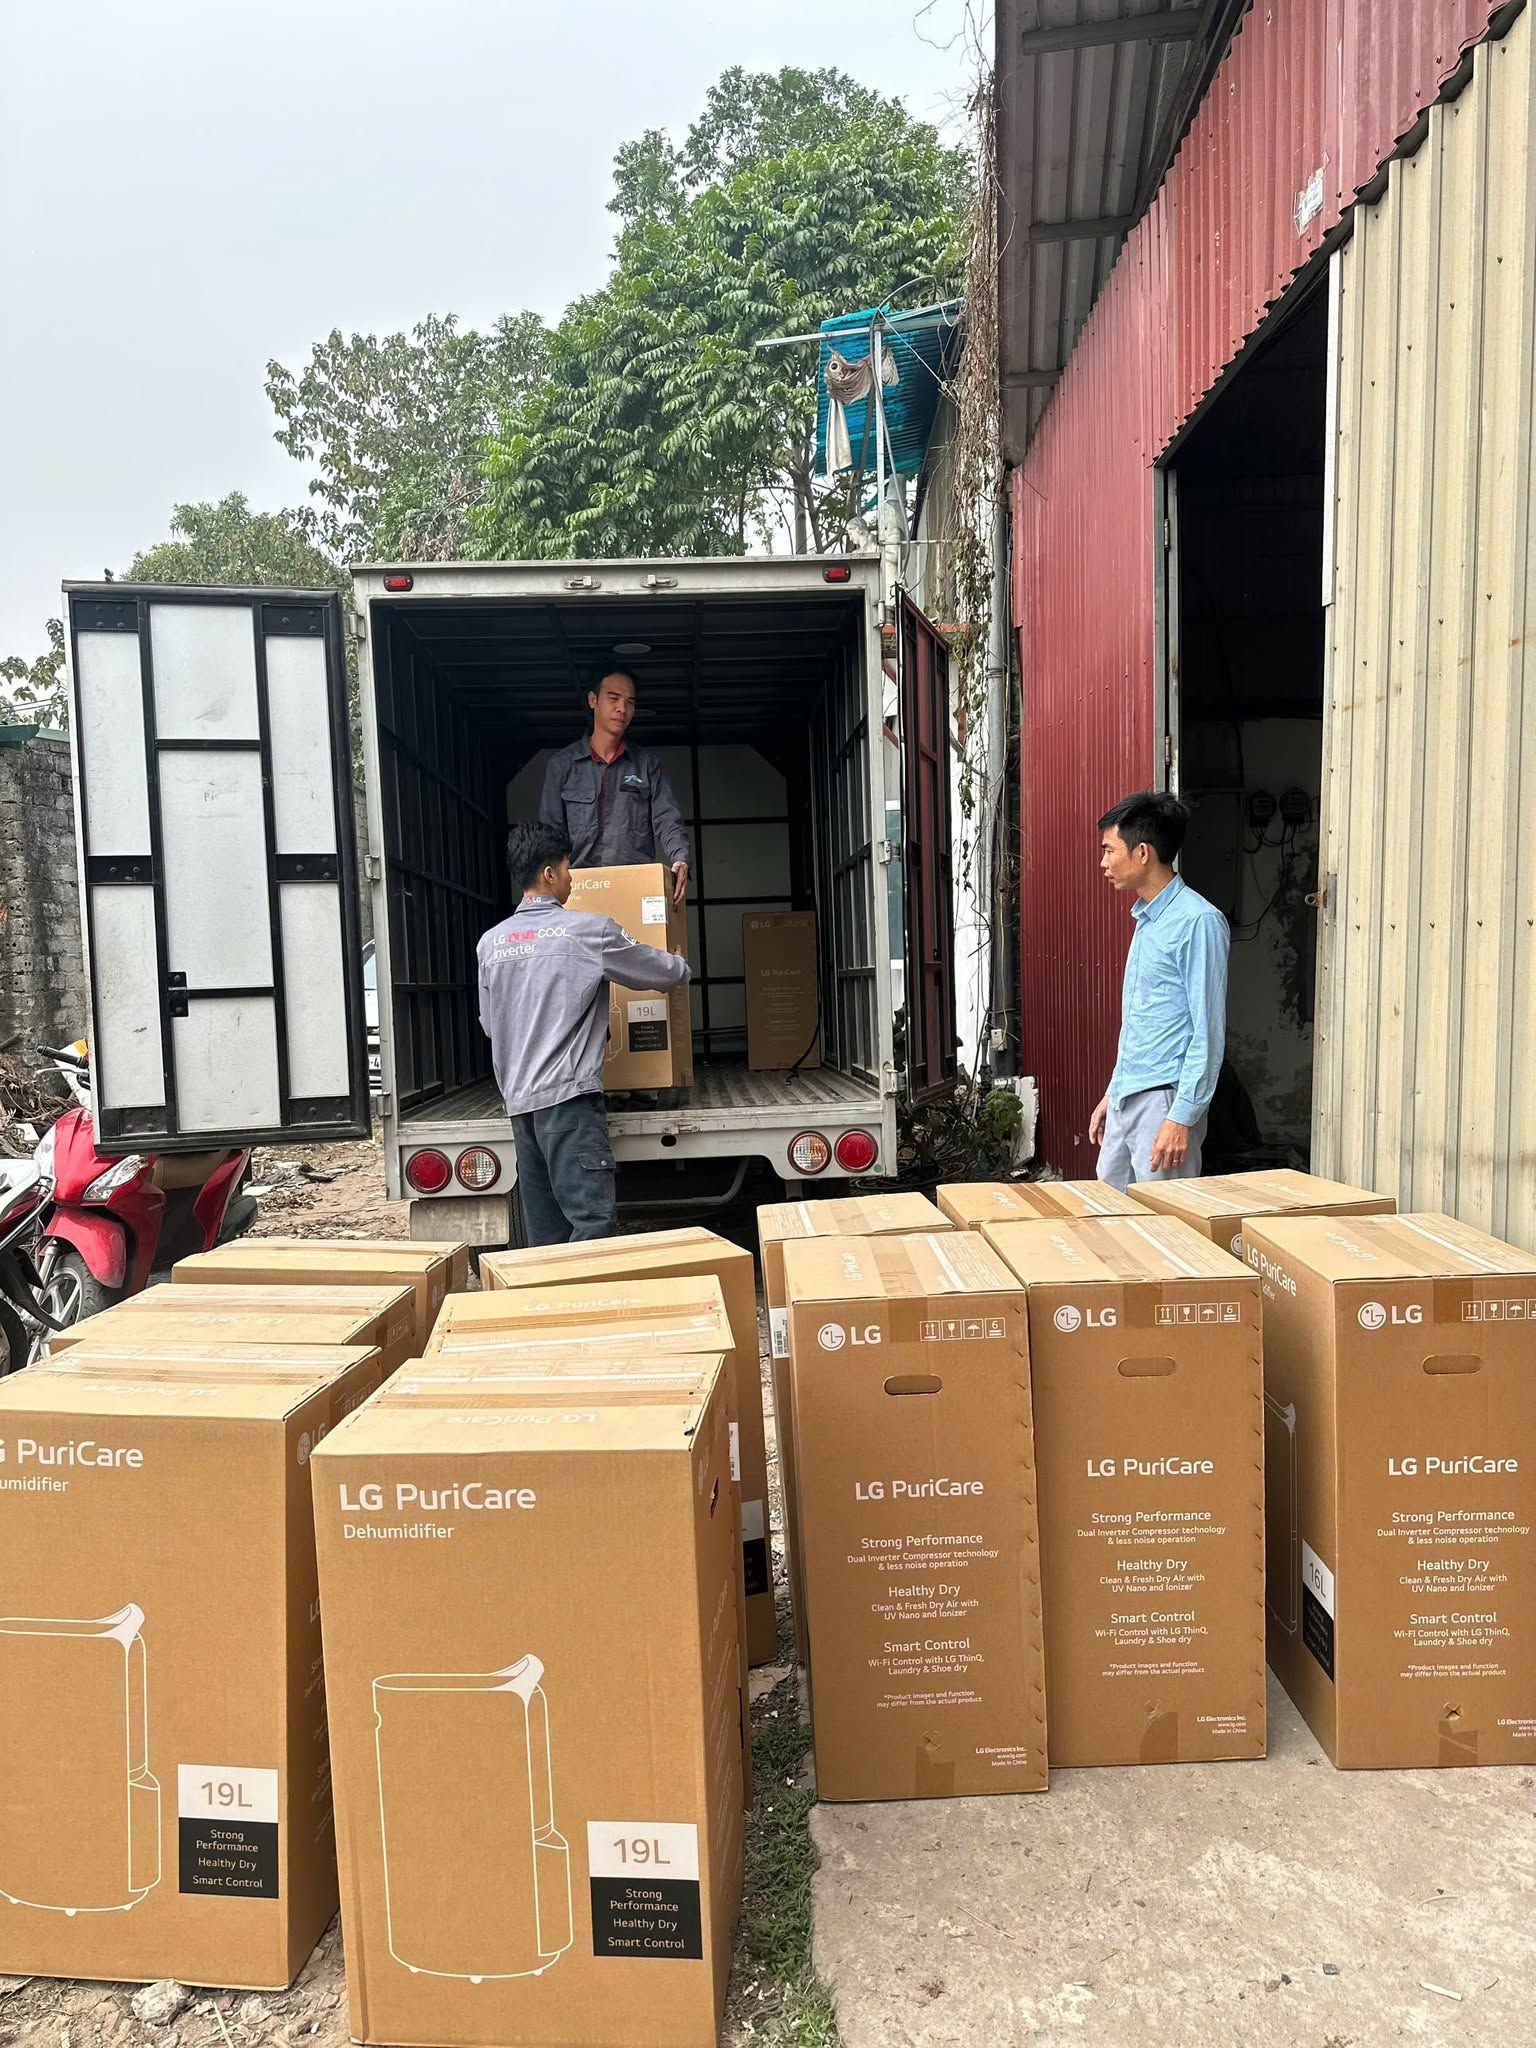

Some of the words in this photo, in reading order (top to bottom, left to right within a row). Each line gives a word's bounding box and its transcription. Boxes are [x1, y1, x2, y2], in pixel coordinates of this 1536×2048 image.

[571, 879, 611, 891] uriCare
[493, 934, 505, 945] LG
[538, 928, 570, 939] COOL
[636, 1006, 656, 1016] 19L
[1247, 1244, 1258, 1268] LG
[1261, 1253, 1296, 1297] PuriCare
[523, 1301, 548, 1312] LG
[558, 1297, 643, 1310] PuriCare
[1226, 1304, 1234, 1314] 6
[1086, 1308, 1117, 1327] LG
[1392, 1304, 1423, 1324] LG
[991, 1320, 999, 1330] 6
[851, 1325, 881, 1346] LG
[447, 1415, 553, 1425] PuriCare
[560, 1413, 598, 1424] LG
[18, 1439, 143, 1468] PuriCare
[1087, 1459, 1115, 1477] LG
[1124, 1457, 1214, 1476] PuriCare
[1388, 1458, 1417, 1476] LG
[1426, 1456, 1518, 1475] PuriCare
[0, 1476, 69, 1492] umidifier
[856, 1482, 884, 1500] LG
[893, 1479, 984, 1498] PuriCare
[339, 1483, 383, 1511] LG
[396, 1482, 537, 1511] PuriCare
[1091, 1513, 1132, 1525] Strong
[1136, 1511, 1211, 1522] Performance
[1392, 1512, 1433, 1525] Strong
[1438, 1510, 1515, 1521] Performance
[343, 1524, 455, 1540] Dehumidifier
[1077, 1529, 1095, 1537] Dual
[1097, 1528, 1129, 1536] Inverter
[1132, 1527, 1179, 1536] Compressor
[1182, 1526, 1226, 1535] technology
[1398, 1528, 1430, 1536] Inverter
[1433, 1527, 1482, 1535] Compressor
[1485, 1526, 1530, 1535] technology
[861, 1537, 902, 1549] Strong
[907, 1534, 983, 1546] Performance
[1107, 1537, 1114, 1545] &
[1134, 1536, 1155, 1544] noise
[1158, 1536, 1195, 1544] operation
[847, 1555, 866, 1564] Dual
[868, 1553, 900, 1562] Inverter
[903, 1552, 951, 1561] Compressor
[954, 1549, 999, 1558] technology
[887, 1562, 903, 1570] less
[905, 1561, 927, 1569] noise
[929, 1560, 968, 1569] operation
[1117, 1560, 1162, 1572] Healthy
[1166, 1559, 1188, 1571] Dry
[1418, 1560, 1464, 1572] Healthy
[1468, 1559, 1490, 1571] Dry
[1100, 1576, 1122, 1584] Clean
[1156, 1575, 1171, 1584] Dry
[1187, 1574, 1204, 1582] with
[1309, 1562, 1326, 1598] 16L
[889, 1585, 935, 1598] Healthy
[939, 1584, 960, 1597] Dry
[1126, 1584, 1147, 1592] Nano
[1166, 1583, 1193, 1591] Ionizer
[871, 1604, 894, 1612] Clean
[896, 1603, 903, 1611] &
[905, 1602, 927, 1610] Fresh
[929, 1601, 944, 1611] Dry
[946, 1600, 958, 1608] Air
[960, 1599, 979, 1607] with
[884, 1612, 897, 1620] UV
[899, 1611, 920, 1619] Nano
[939, 1609, 967, 1618] Ionizer
[1111, 1613, 1147, 1624] Smart
[1151, 1611, 1195, 1622] Control
[1410, 1614, 1448, 1625] Smart
[1451, 1612, 1497, 1623] Control
[1095, 1629, 1117, 1637] Wi-Fi
[1119, 1628, 1148, 1636] Control
[1394, 1630, 1416, 1638] Wi-Fi
[1418, 1629, 1449, 1638] Control
[1451, 1629, 1469, 1637] with
[884, 1642, 921, 1653] Smart
[925, 1638, 970, 1651] Control
[1115, 1636, 1146, 1646] Laundry
[1157, 1636, 1176, 1644] Shoe
[1178, 1636, 1192, 1645] dry
[1413, 1638, 1446, 1647] Laundry
[1457, 1637, 1477, 1645] Shoe
[1480, 1637, 1493, 1647] dry
[868, 1659, 890, 1667] Wi-Fi
[892, 1657, 923, 1666] Control
[925, 1656, 943, 1664] with
[945, 1655, 956, 1664] LG
[888, 1666, 921, 1675] Laundry
[931, 1665, 951, 1673] Shoe
[954, 1664, 968, 1673] dry
[201, 1781, 253, 1808] 19L
[210, 1829, 244, 1842] Strong
[196, 1840, 259, 1853] Performance
[613, 1838, 671, 1865] 19L
[198, 1857, 236, 1870] Healthy
[239, 1860, 257, 1871] Dry
[192, 1876, 223, 1887] Smart
[225, 1877, 263, 1888] Control
[625, 1889, 662, 1901] Strong
[610, 1900, 679, 1912] Performance
[613, 1918, 654, 1931] Healthy
[658, 1920, 677, 1931] Dry
[608, 1937, 641, 1948] Smart
[643, 1938, 685, 1949] Control
